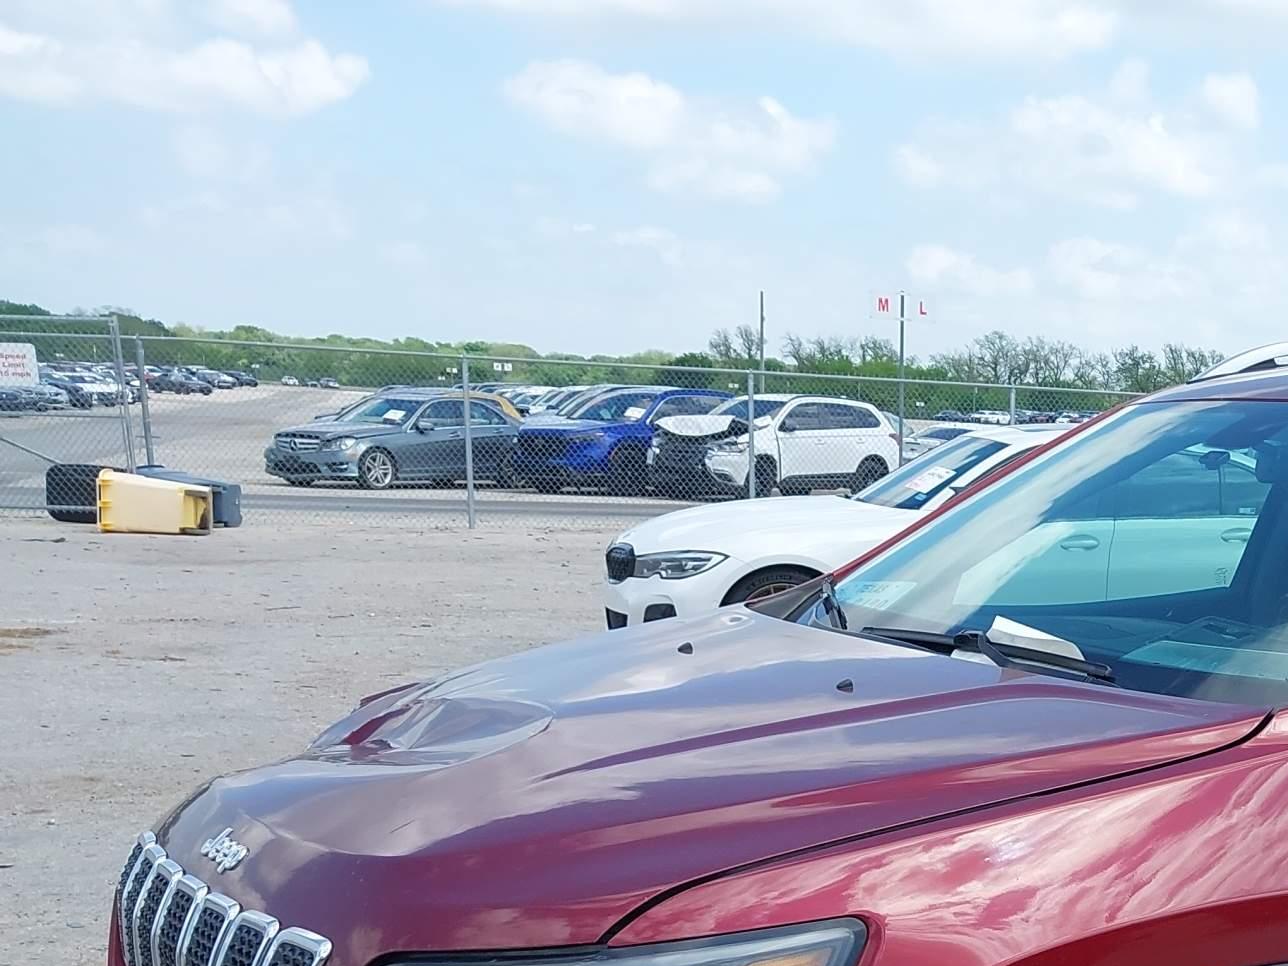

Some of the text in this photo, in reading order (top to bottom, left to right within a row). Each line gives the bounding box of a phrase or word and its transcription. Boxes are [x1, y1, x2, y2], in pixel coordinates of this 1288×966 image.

[878, 297, 889, 312] M
[919, 300, 927, 315] L
[200, 827, 248, 874] Jeep
